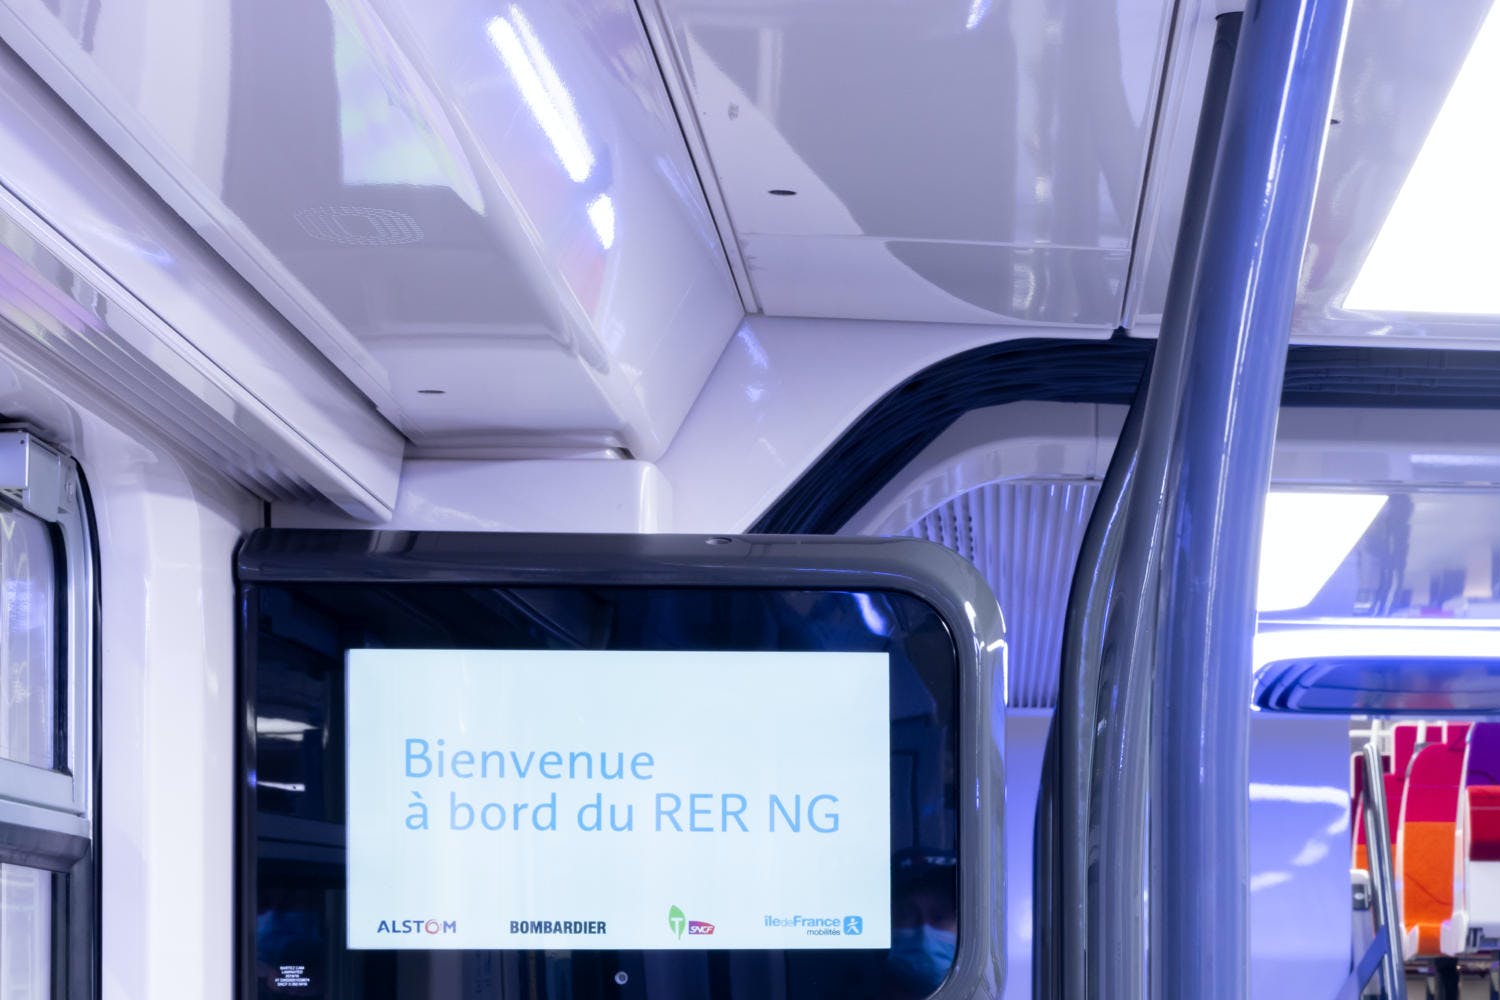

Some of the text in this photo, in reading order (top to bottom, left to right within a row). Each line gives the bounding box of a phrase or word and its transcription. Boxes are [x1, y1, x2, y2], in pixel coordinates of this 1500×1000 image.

[405, 738, 655, 780] Bienvenue
[404, 790, 840, 834] à bord du RER NG
[376, 917, 457, 935] ALSTOM
[509, 920, 607, 935] BOMBARDIER
[689, 925, 714, 935] SNCF
[806, 927, 841, 936] mobilités
